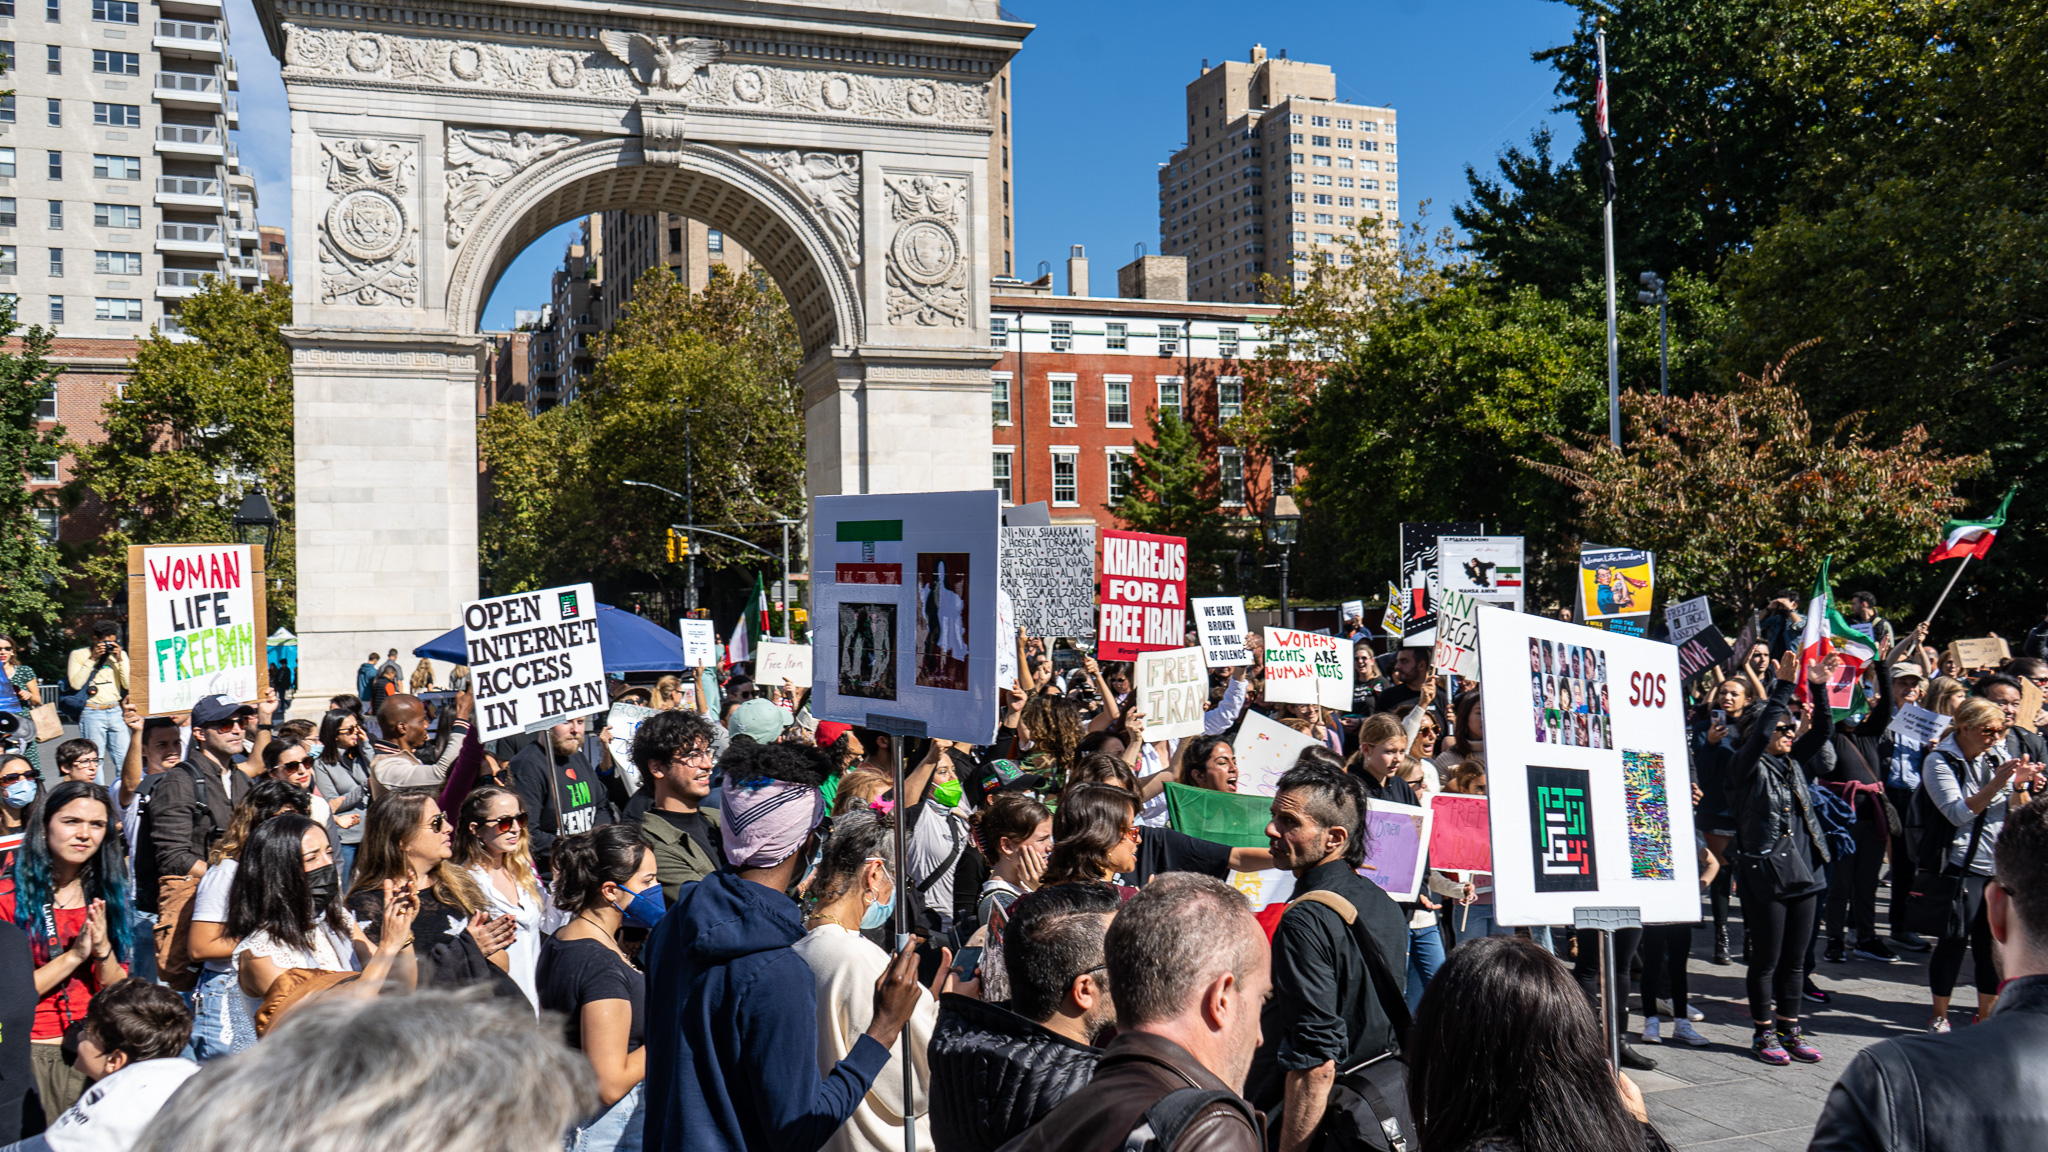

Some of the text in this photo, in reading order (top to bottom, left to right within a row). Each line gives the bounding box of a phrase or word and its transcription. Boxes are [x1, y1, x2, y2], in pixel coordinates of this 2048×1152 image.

[1019, 527, 1036, 538] NIKA
[1040, 527, 1083, 538] SHAKARAMI
[1009, 538, 1041, 548] HOSSEIN
[1042, 538, 1090, 548] TORKAMAN
[1047, 548, 1088, 557] PEDRAM
[1103, 537, 1186, 582] KHAREJIS
[149, 551, 241, 592] WOMAN
[1020, 558, 1061, 568] ROOZBEH
[1015, 568, 1055, 578] HAGHIGHI
[1061, 568, 1076, 578] ALI
[1067, 578, 1094, 587] MILAD
[1109, 579, 1180, 605] FOR A
[170, 591, 231, 632] LIFE
[1044, 598, 1066, 609] AMIR
[1203, 605, 1234, 617] WE HAVE
[1440, 588, 1475, 619] ZAN
[1666, 601, 1700, 620] FREEZE
[465, 595, 542, 631] OPEN
[1014, 608, 1082, 619] HADIS NAJAFI
[1685, 611, 1706, 625] IRGC
[1046, 619, 1064, 628] ASL
[1067, 619, 1092, 628] YASIN
[1100, 603, 1185, 646] FREE IRAN
[1207, 620, 1236, 631] BROKEN
[1208, 635, 1242, 646] THE WALL
[1274, 631, 1337, 650] WOMENS
[1672, 624, 1700, 641] ASSETS
[468, 618, 598, 667] INTERNET
[155, 622, 253, 683] FREEDOM
[763, 652, 803, 670] Free Iran
[1209, 649, 1247, 661] OF SILENCE
[1266, 648, 1339, 664] RIGHTS ARE
[476, 652, 572, 700] ACCESS
[1146, 654, 1199, 688] FREE
[1265, 663, 1343, 680] HUMAN RIGTS
[1629, 670, 1666, 709] SOS
[484, 680, 603, 732] IN IRAN
[611, 704, 651, 719] FROM
[1146, 682, 1208, 727] IRAN
[1907, 713, 1928, 723] STAND
[1450, 802, 1488, 829] FREE
[42, 903, 56, 937] LUMIX
